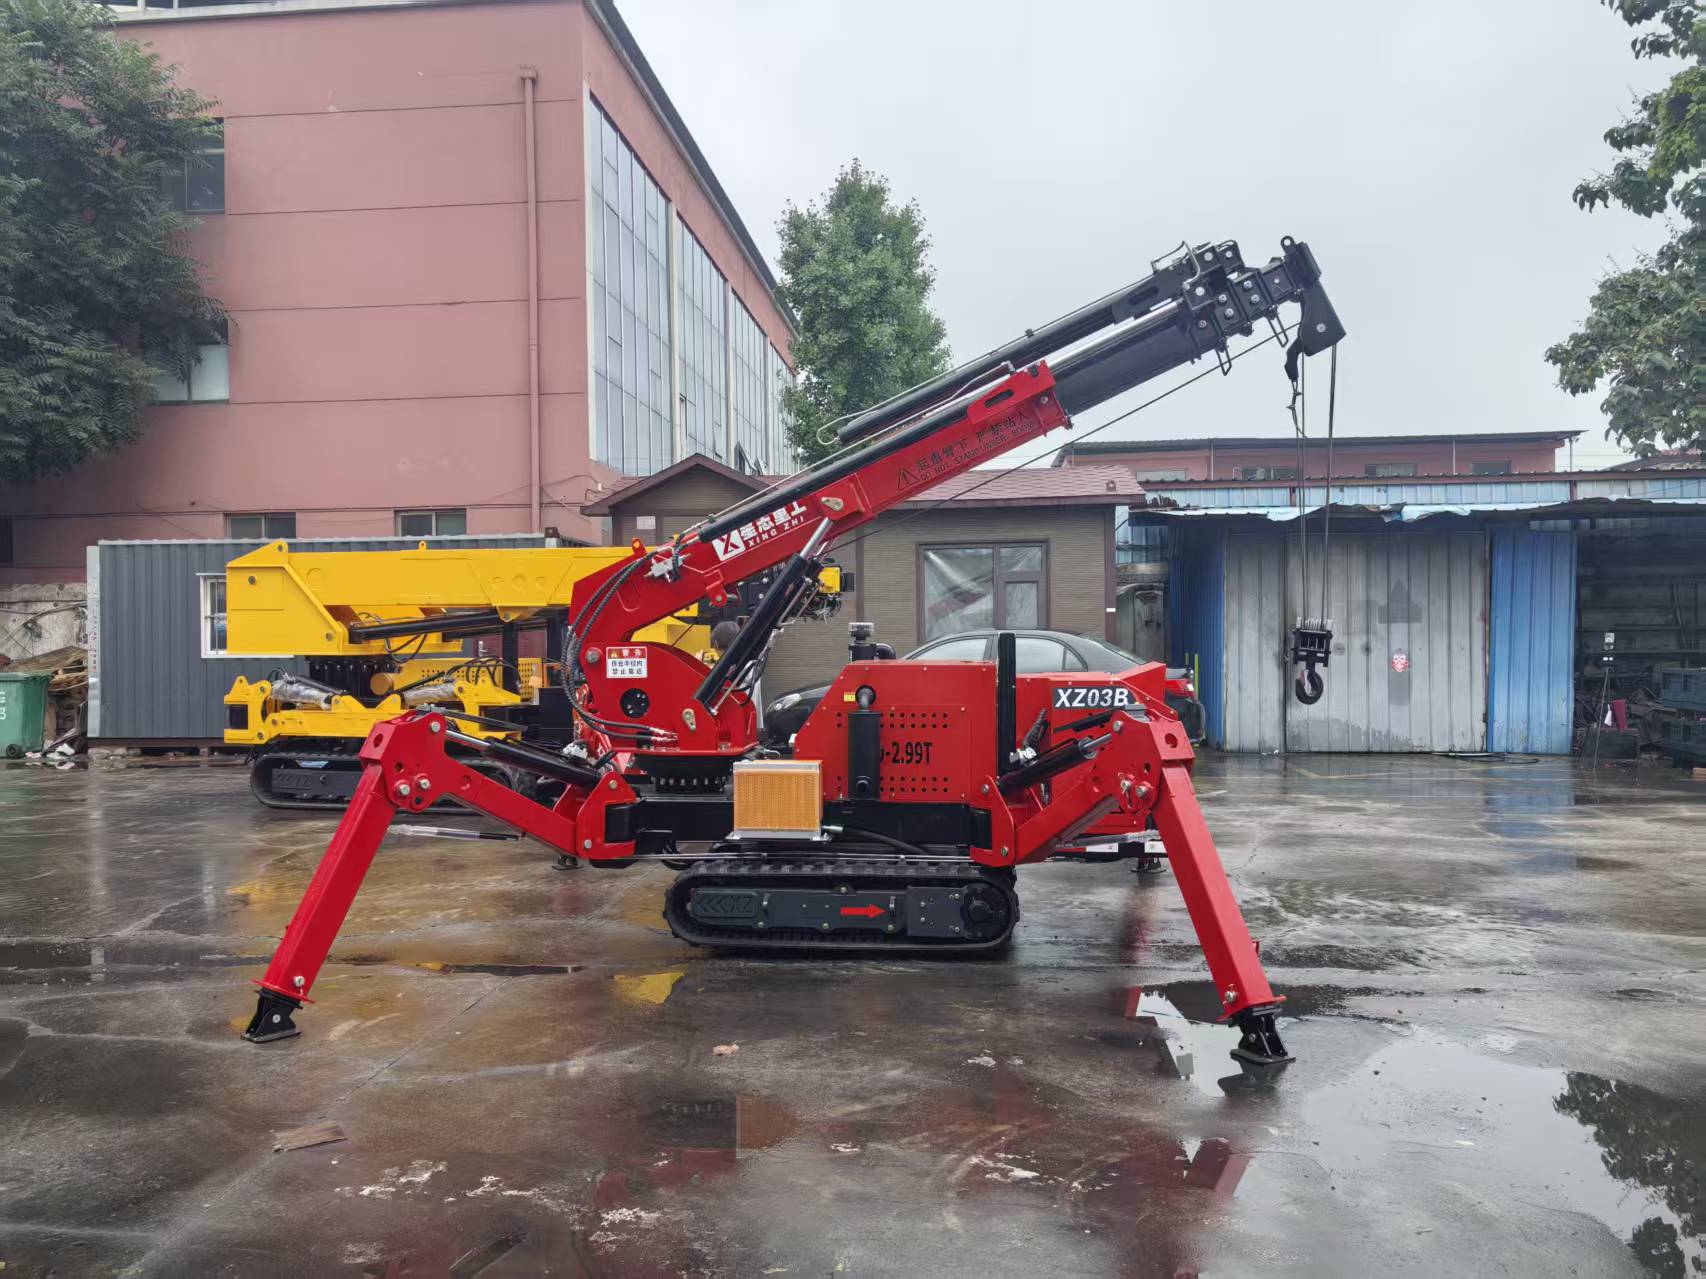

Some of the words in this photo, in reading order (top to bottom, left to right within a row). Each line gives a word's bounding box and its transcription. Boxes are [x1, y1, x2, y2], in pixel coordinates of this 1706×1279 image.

[955, 448, 979, 465] STAND
[748, 528, 778, 547] XING
[783, 515, 804, 531] ZHI
[1055, 688, 1129, 708] XZ03B
